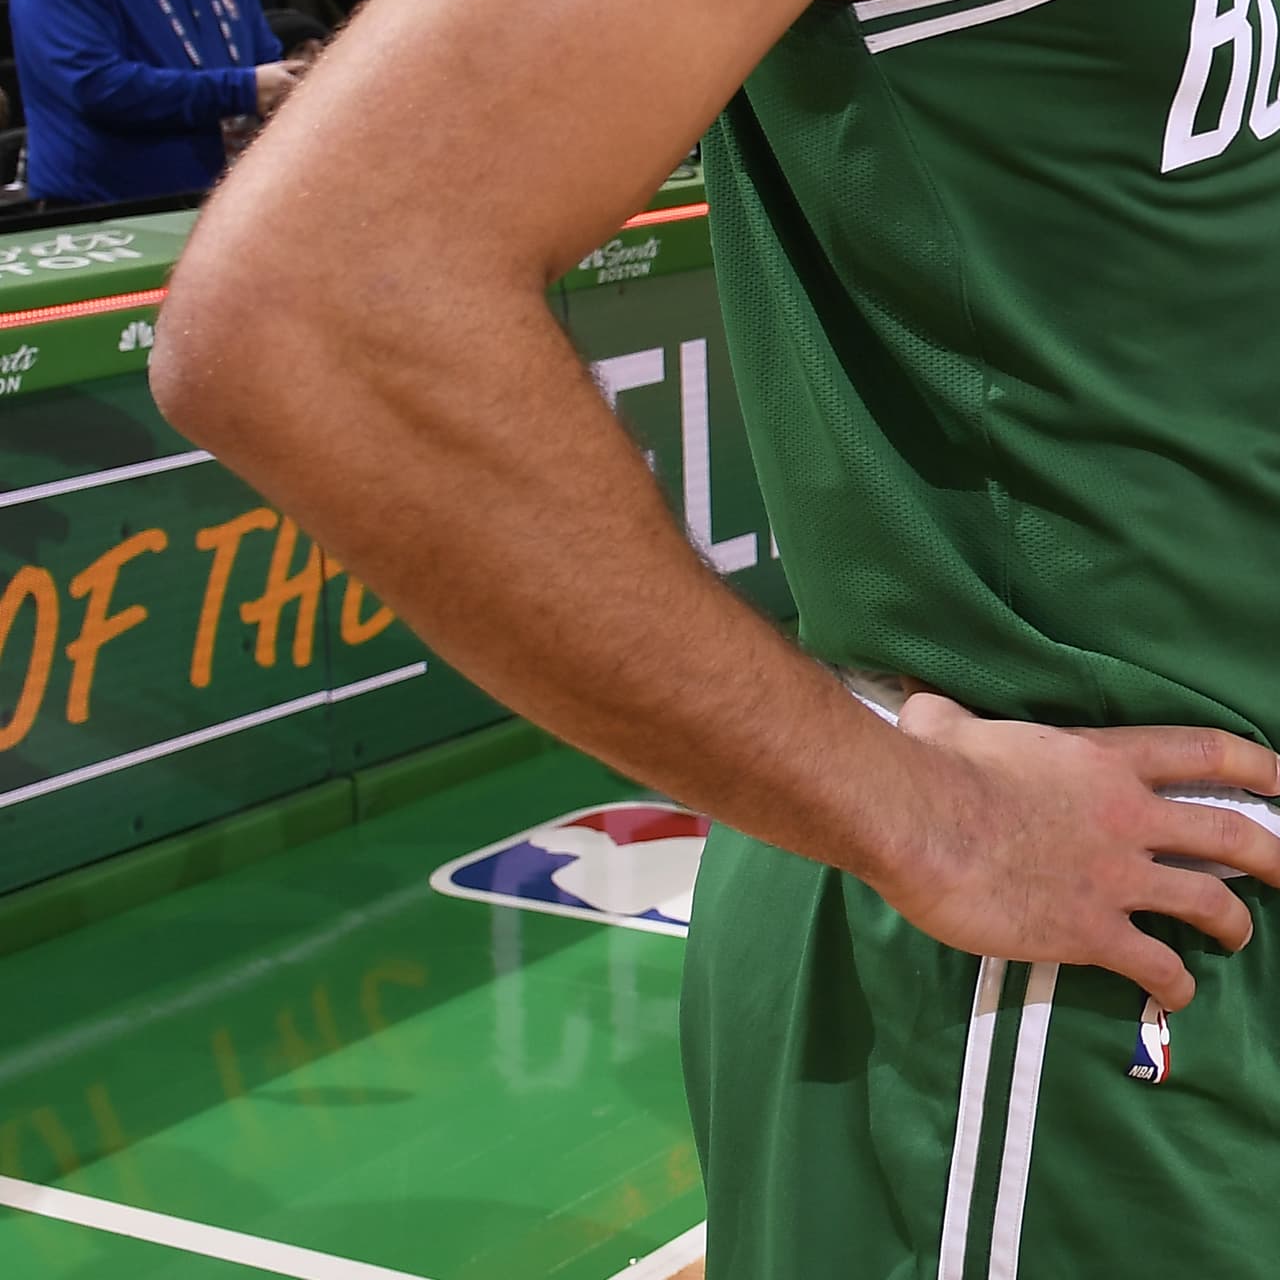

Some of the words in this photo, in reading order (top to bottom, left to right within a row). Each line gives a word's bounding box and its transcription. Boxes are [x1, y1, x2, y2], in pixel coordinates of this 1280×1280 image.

[597, 261, 652, 285] BOSTON
[0, 527, 169, 752] OF
[1128, 1064, 1156, 1081] NBA
